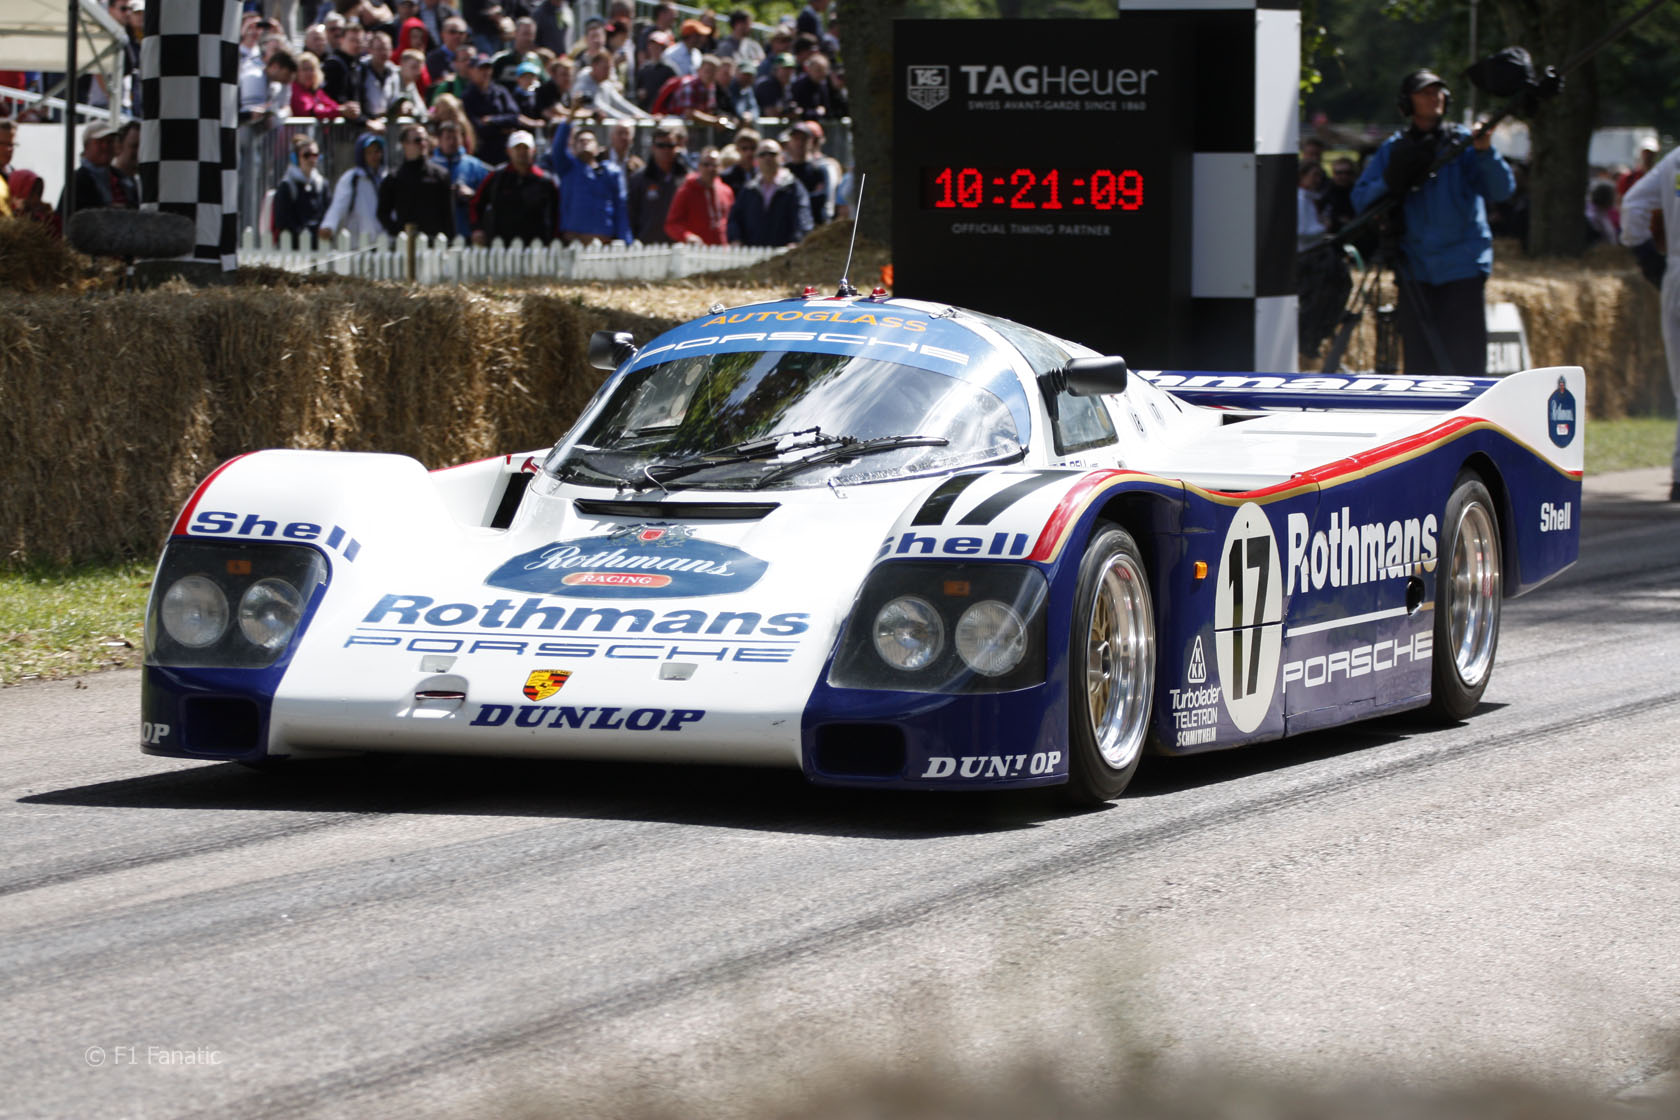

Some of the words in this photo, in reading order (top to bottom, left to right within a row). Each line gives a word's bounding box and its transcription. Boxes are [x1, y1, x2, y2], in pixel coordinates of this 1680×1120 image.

[915, 69, 943, 86] TAG
[968, 101, 1000, 111] SWISS
[1003, 101, 1080, 111] AVANT-GARDE
[1084, 101, 1117, 111] SINCE
[951, 223, 1006, 234] OFFICIAL
[1010, 224, 1053, 235] TIMING
[1058, 225, 1111, 236] PARTNER
[701, 311, 927, 332] AUTOGLASS
[634, 332, 970, 366] PORSCHE
[910, 471, 1080, 527] 17
[1540, 502, 1571, 533] Shell
[191, 511, 362, 563] Shell
[1286, 506, 1438, 596] Rothmans
[524, 546, 736, 576] Rothmans
[580, 575, 652, 584] RACING
[362, 594, 809, 636] Rothmans
[1228, 535, 1271, 700] 17
[343, 635, 796, 663] PORSCHE
[1282, 631, 1433, 693] PORSCHE
[1169, 684, 1222, 710] Turbolader
[469, 703, 706, 731] DUNLOP
[1173, 707, 1218, 729] TELETRON
